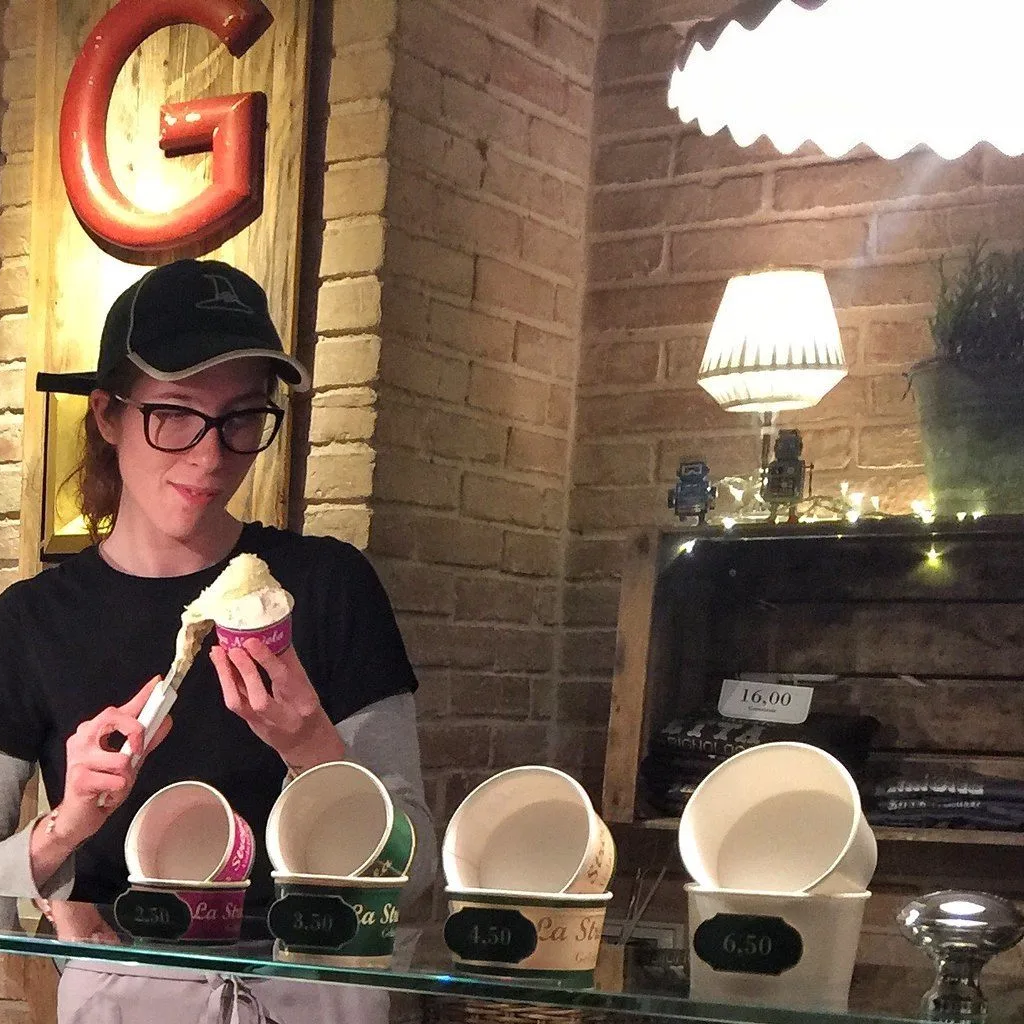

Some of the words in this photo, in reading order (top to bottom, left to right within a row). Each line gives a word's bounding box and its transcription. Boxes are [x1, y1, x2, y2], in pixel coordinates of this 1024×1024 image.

[59, 0, 274, 266] G
[739, 687, 793, 709] 16,00
[191, 901, 218, 921] La
[537, 917, 569, 941] La
